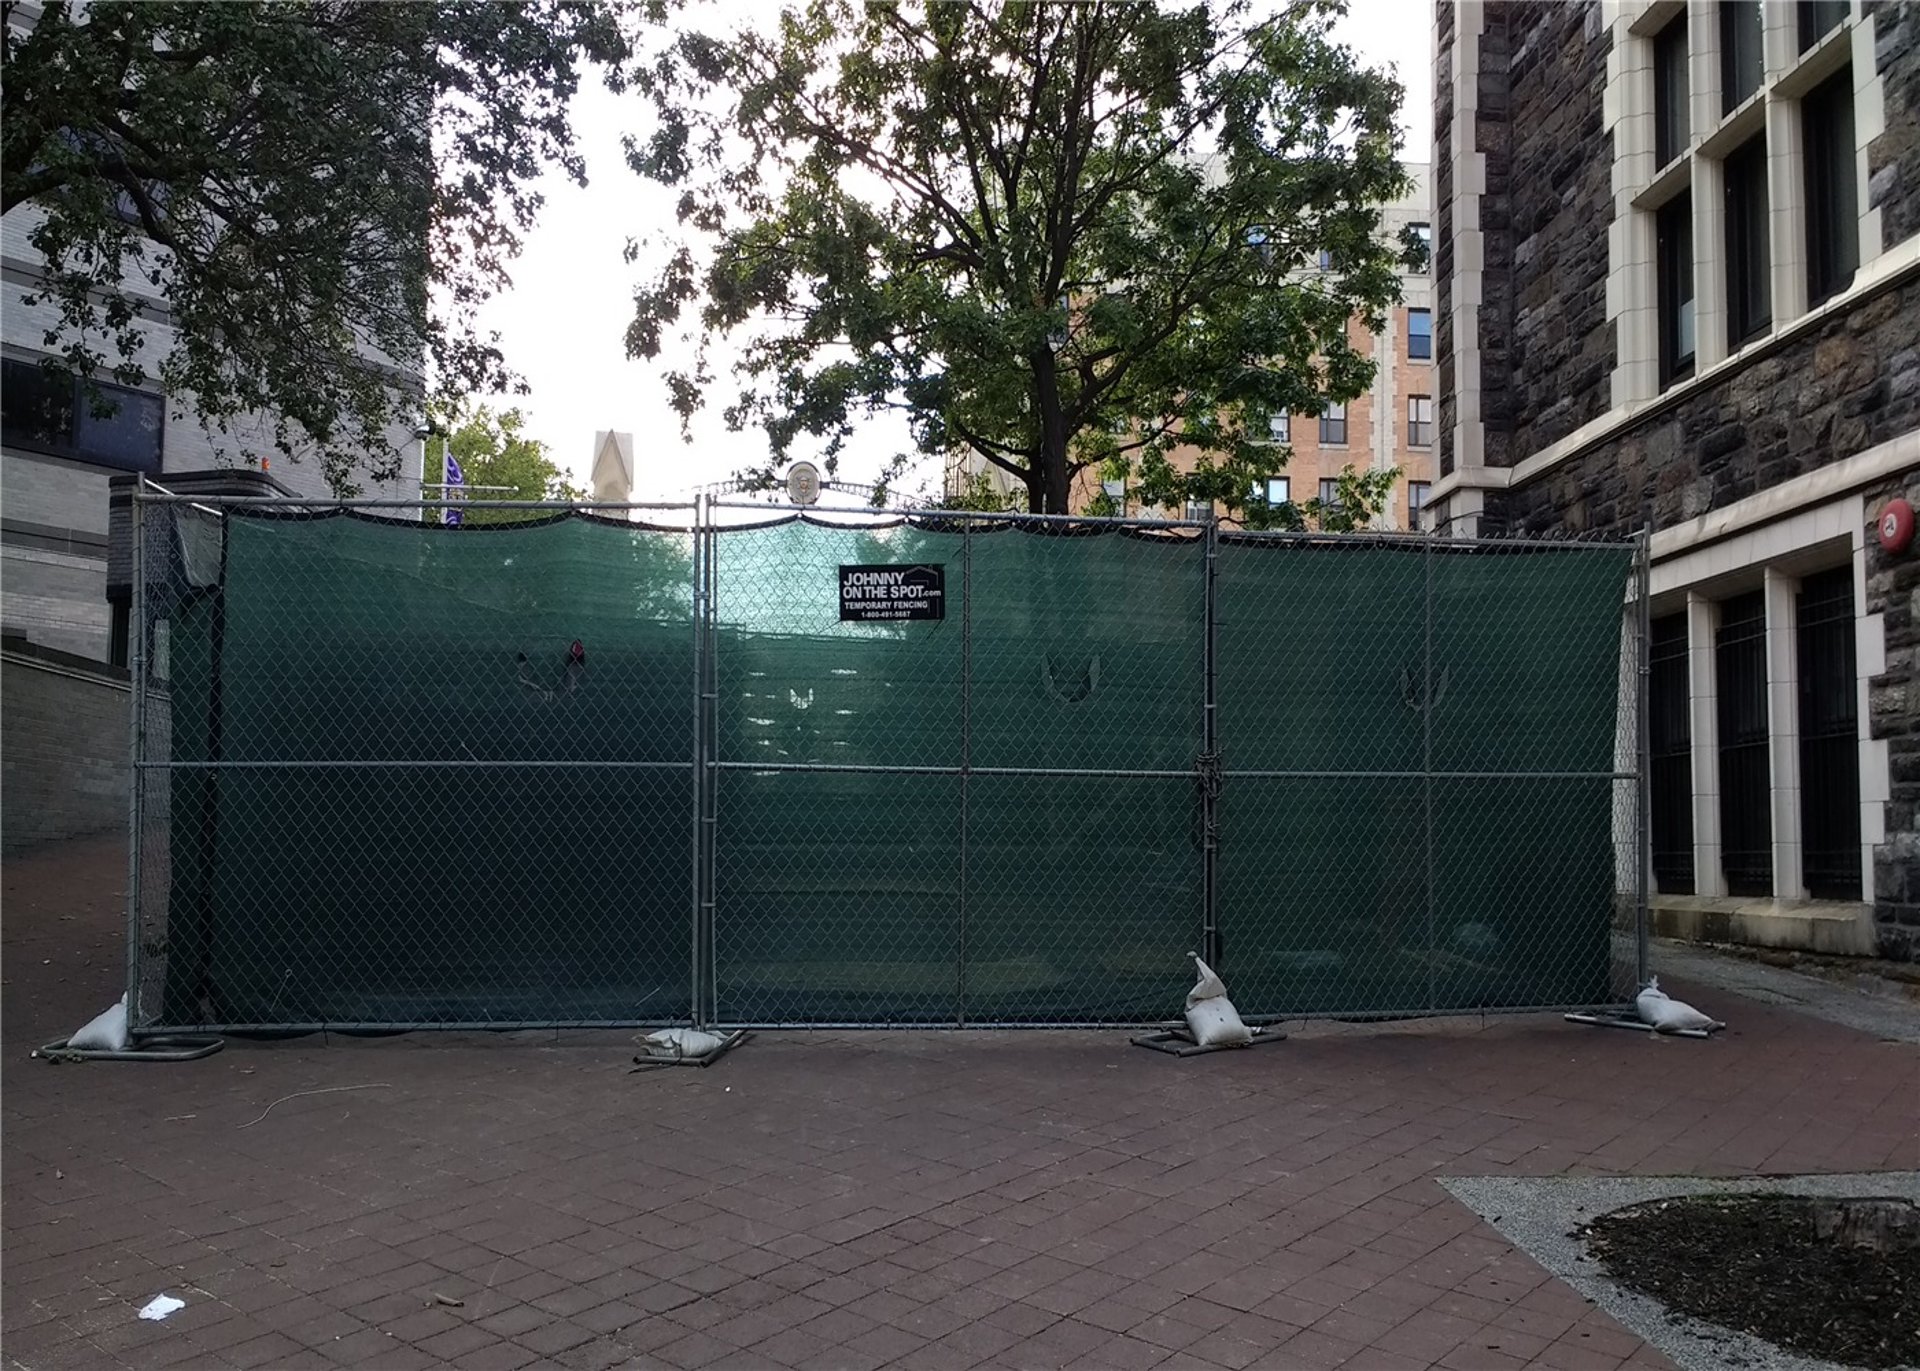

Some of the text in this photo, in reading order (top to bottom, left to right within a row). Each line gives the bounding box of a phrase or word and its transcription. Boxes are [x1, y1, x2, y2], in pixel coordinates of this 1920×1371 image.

[843, 572, 905, 586] JOHNNY
[842, 585, 942, 599] ON THE SPOT.com
[844, 600, 928, 610] TEMPORARY FENCING
